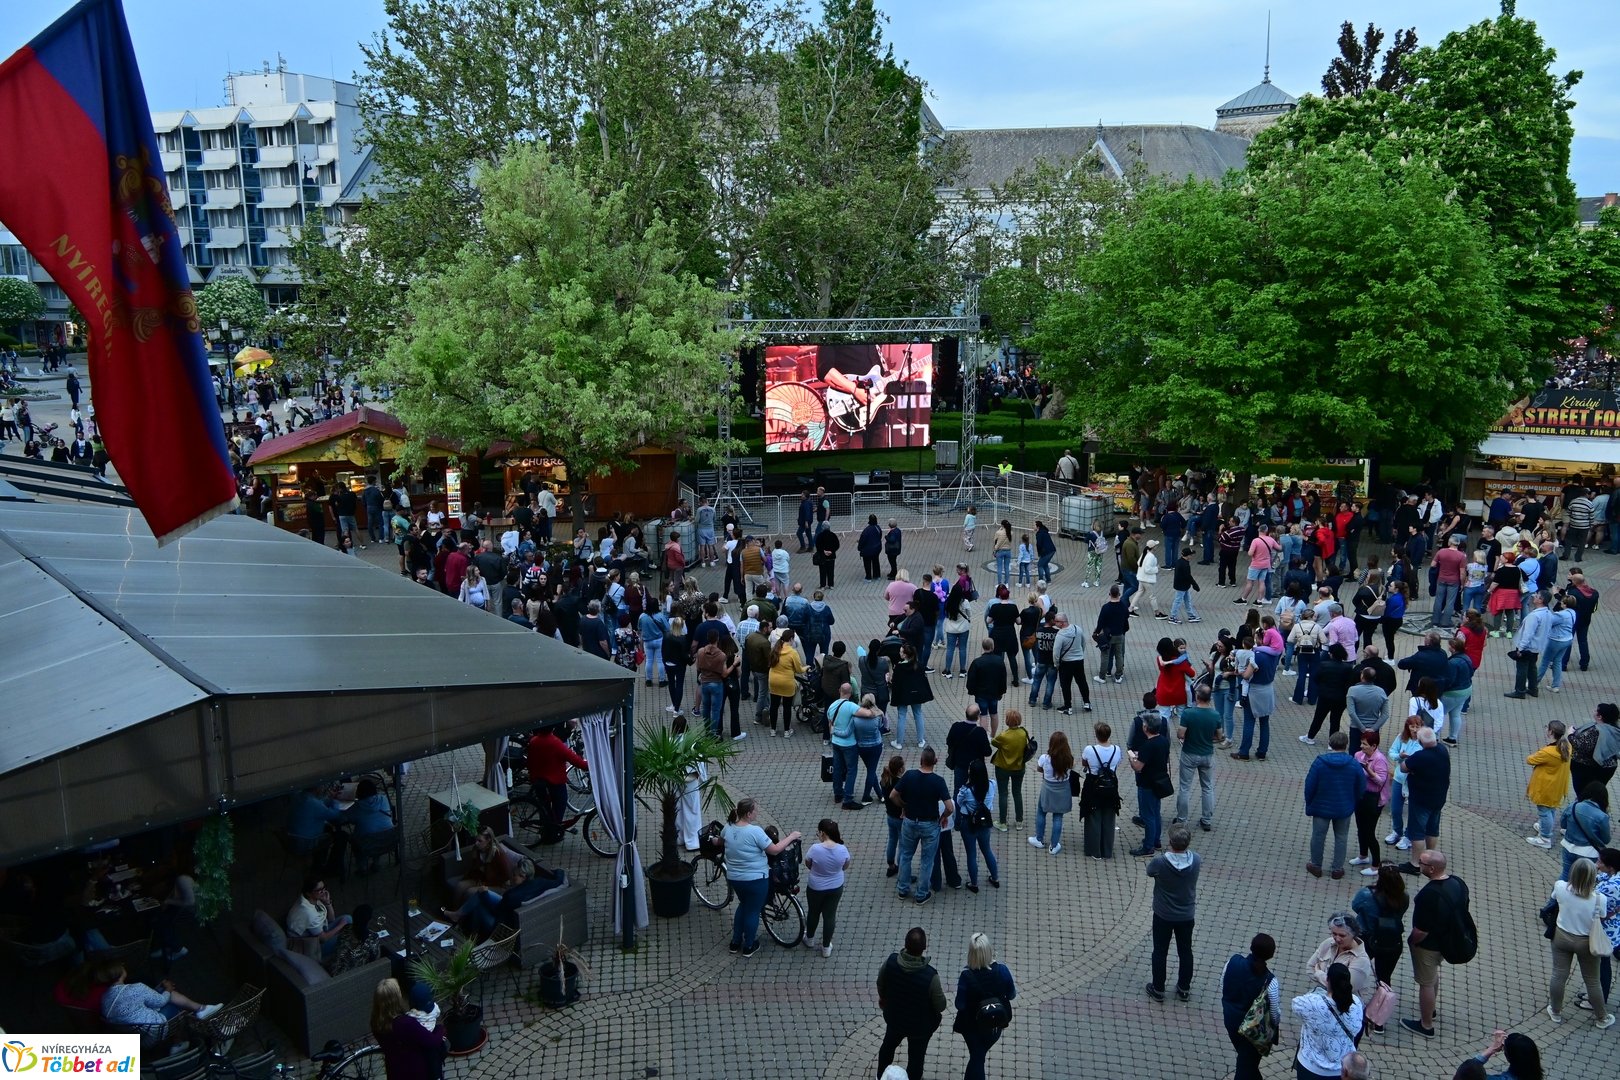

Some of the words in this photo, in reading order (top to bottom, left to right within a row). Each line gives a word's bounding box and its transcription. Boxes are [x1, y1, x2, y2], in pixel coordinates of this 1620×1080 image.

[1560, 395, 1601, 411] Királyi
[1525, 407, 1590, 426] STREET
[1560, 428, 1588, 436] GYROS,
[1590, 428, 1612, 437] FÁNK,
